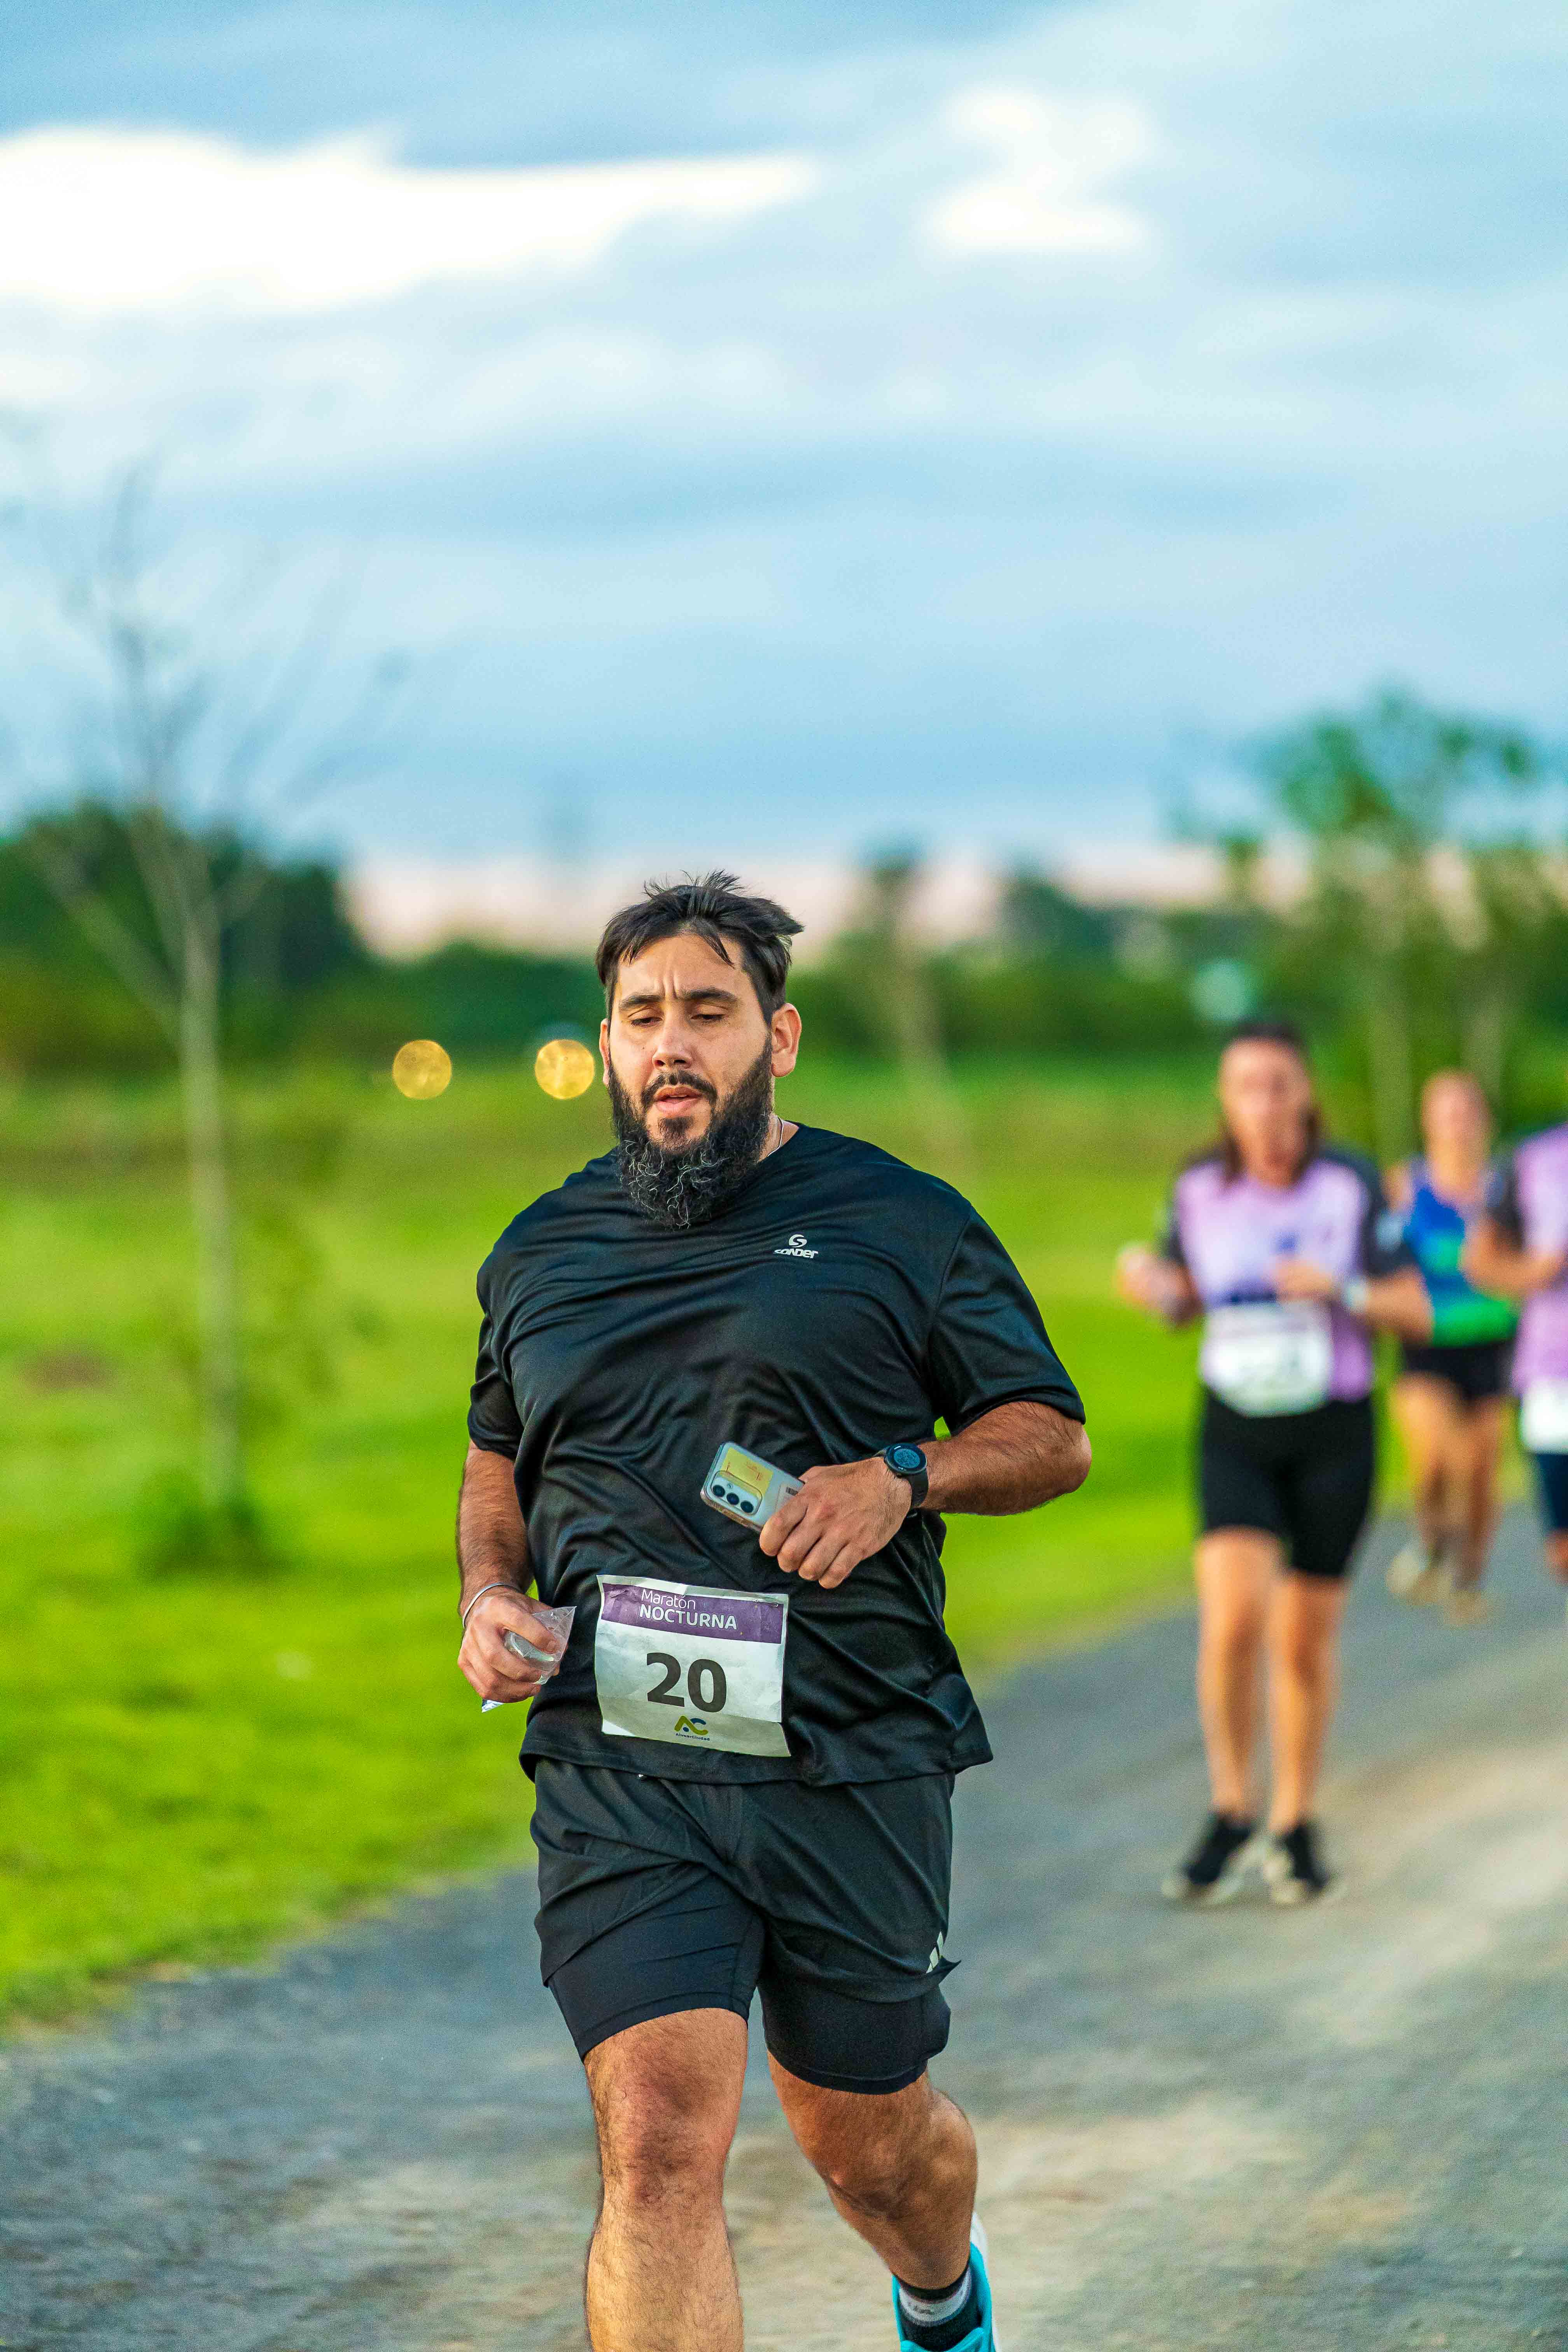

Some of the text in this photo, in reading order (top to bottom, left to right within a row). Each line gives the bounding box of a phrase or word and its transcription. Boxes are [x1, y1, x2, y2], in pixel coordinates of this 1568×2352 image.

[641, 1589, 696, 1610] Maratón
[639, 1604, 737, 1630] NOCTURNA
[647, 1652, 727, 1713] 20
